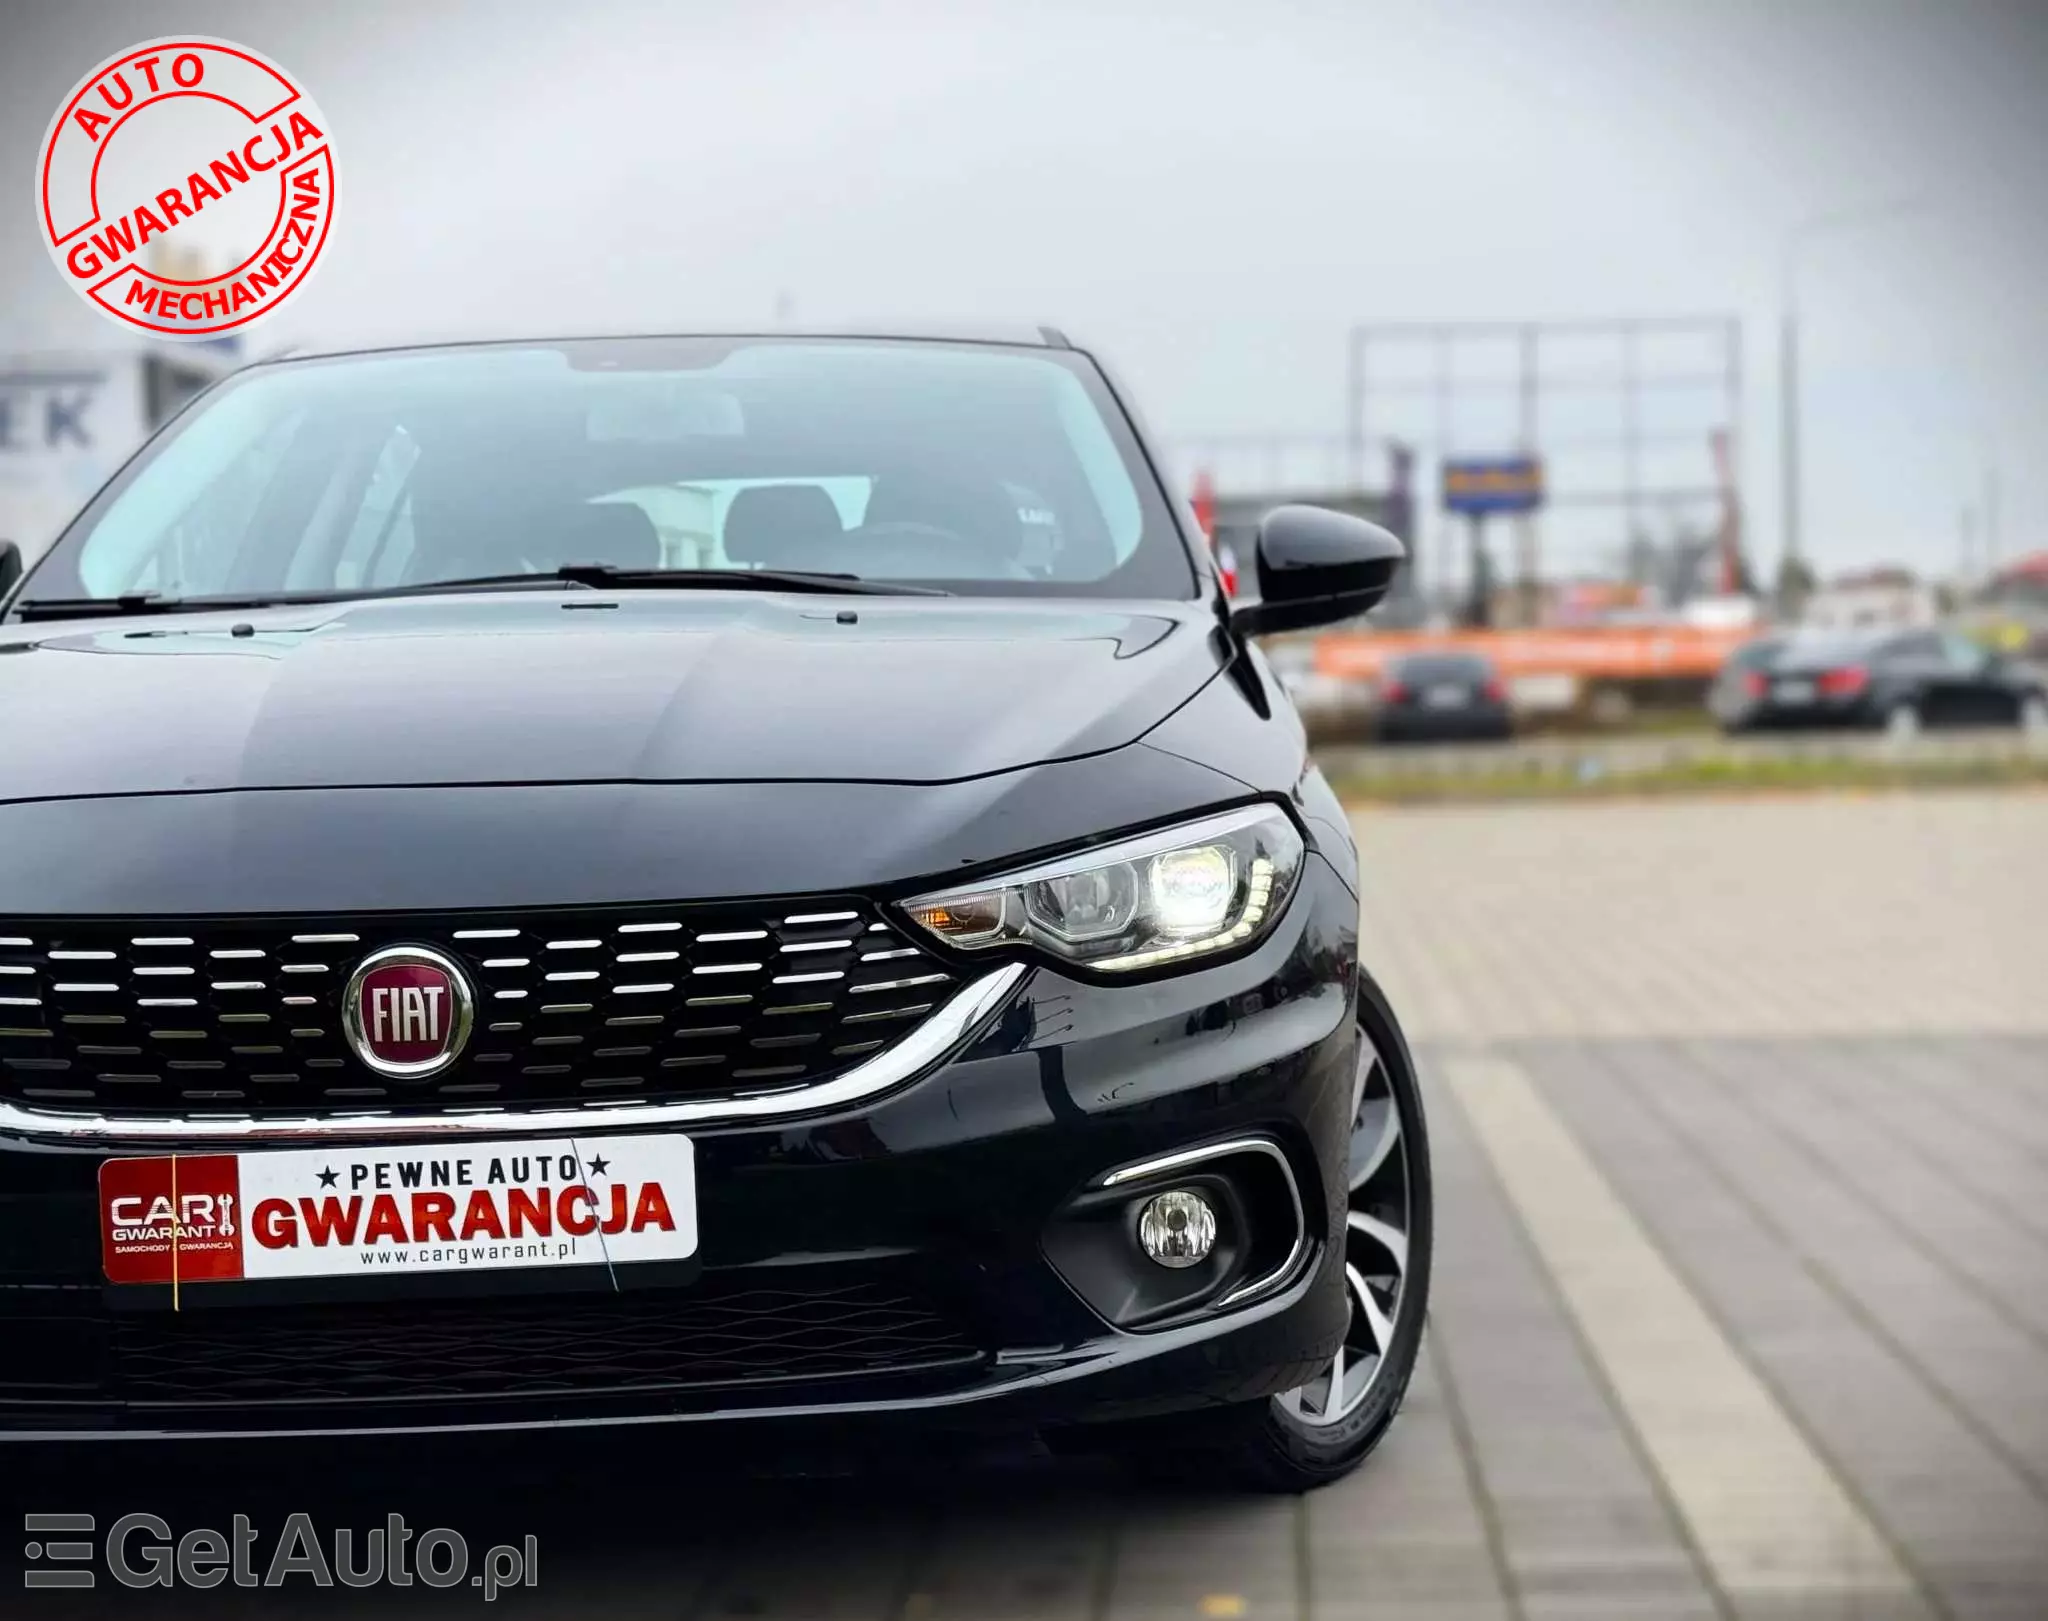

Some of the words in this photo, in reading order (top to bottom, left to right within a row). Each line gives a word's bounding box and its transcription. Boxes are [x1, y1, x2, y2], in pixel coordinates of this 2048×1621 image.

[372, 986, 444, 1042] FIAT
[351, 1159, 473, 1190] PEWNE
[487, 1154, 577, 1184] AUTO
[111, 1194, 216, 1226] CAR
[251, 1182, 676, 1250] GWARANCJA
[112, 1225, 216, 1242] GWARANT
[115, 1244, 170, 1254] SAMOCHODY
[360, 1237, 577, 1265] www.cargwarant.pl
